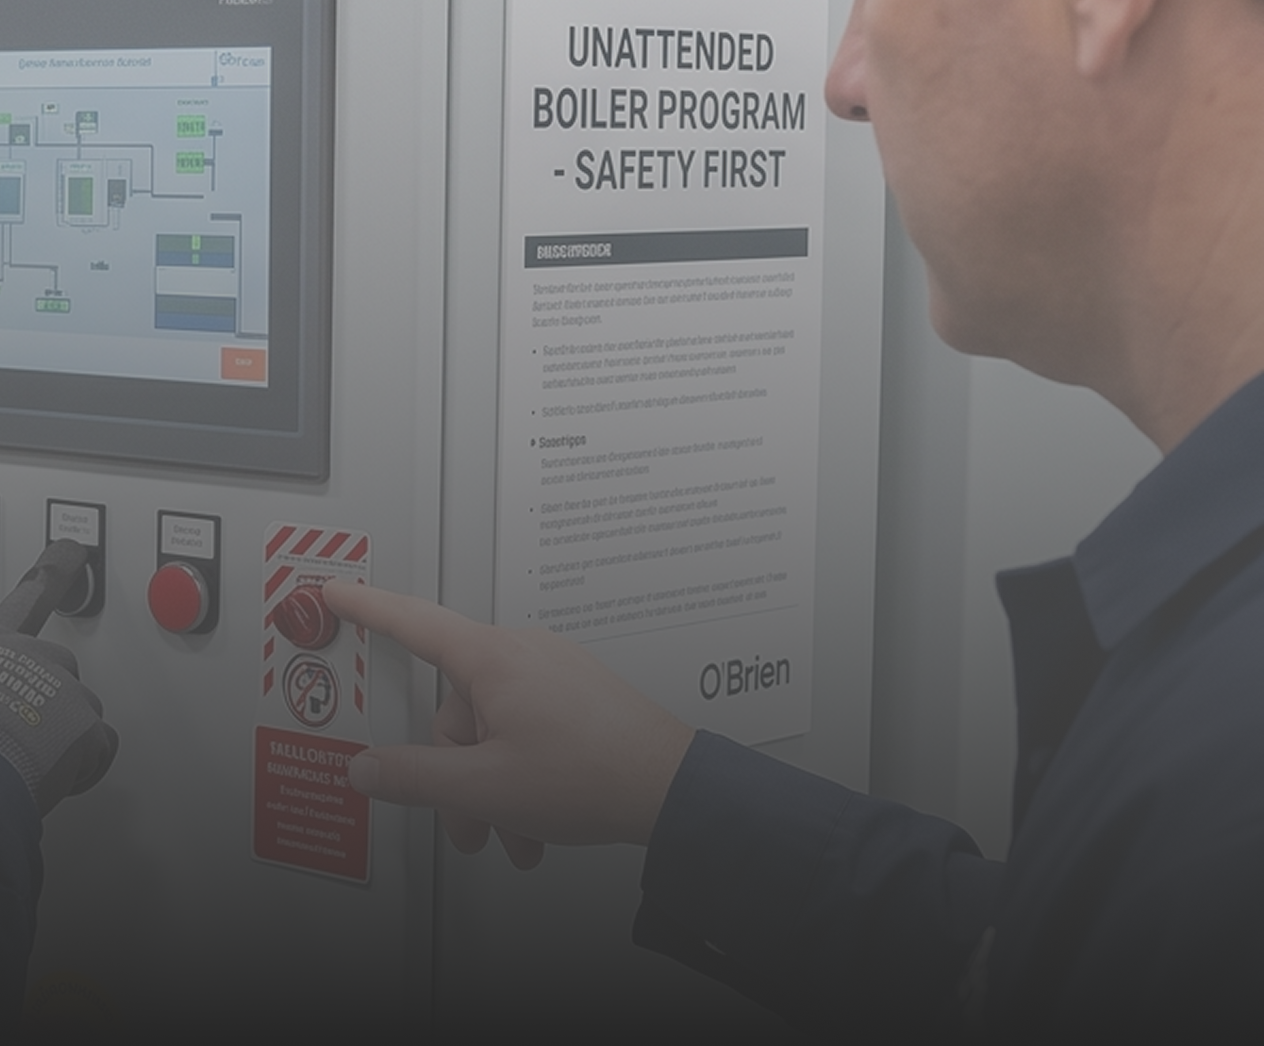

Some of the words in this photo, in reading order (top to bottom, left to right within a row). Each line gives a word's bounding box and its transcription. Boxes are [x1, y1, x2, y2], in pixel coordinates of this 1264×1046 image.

[568, 26, 773, 71] UNATTENDED
[533, 87, 648, 129] BOILER
[658, 90, 805, 130] PROGRAM
[553, 168, 564, 177] -
[575, 149, 695, 190] SAFETY
[703, 150, 786, 188] FIRST
[700, 655, 789, 701] O'Brien
